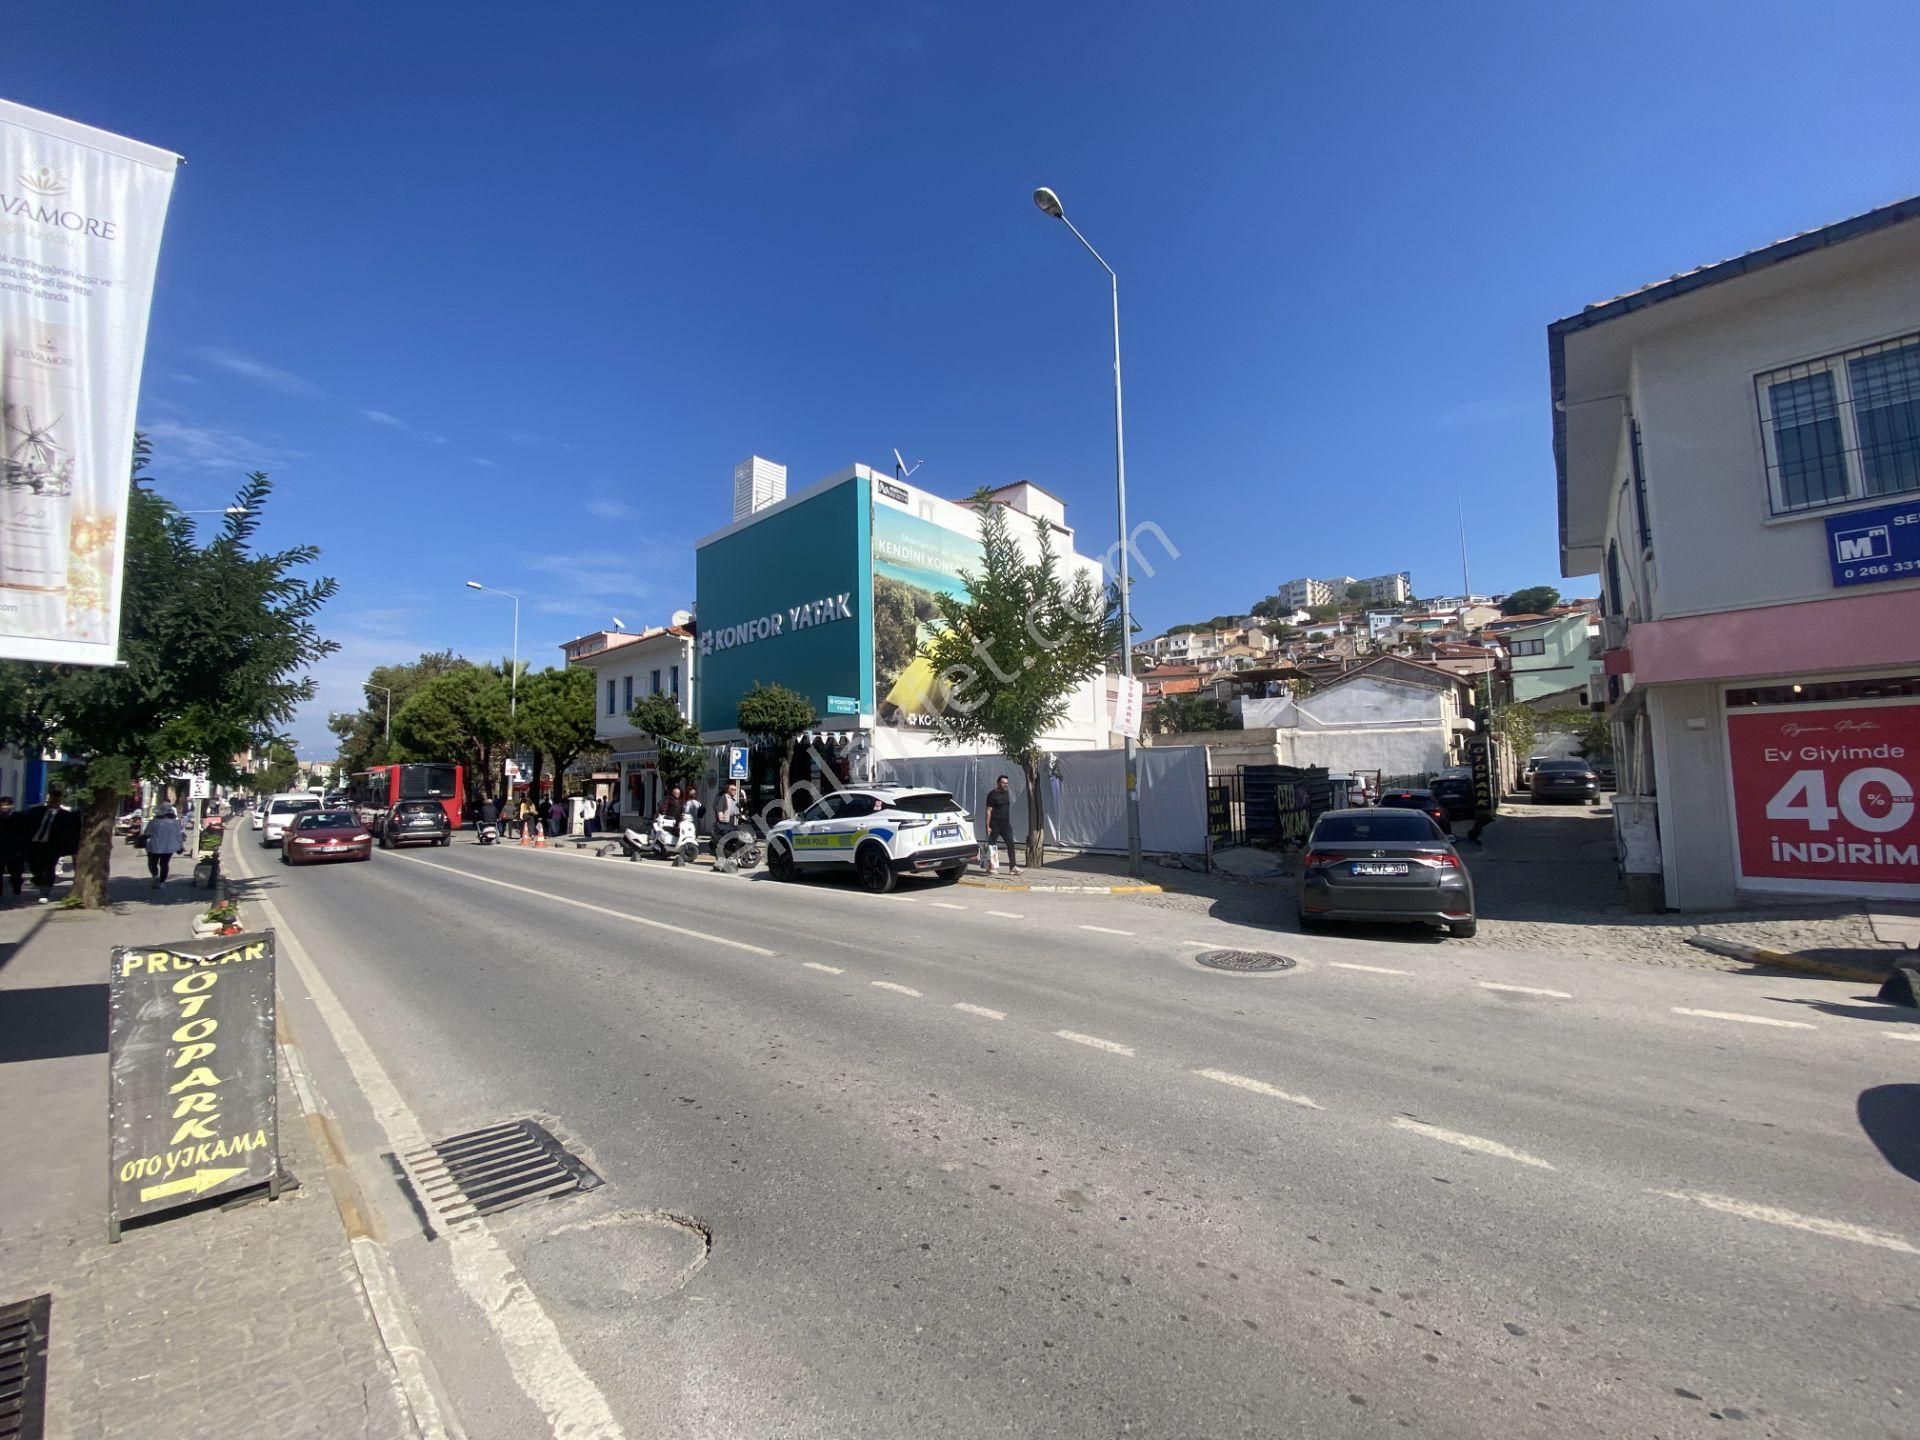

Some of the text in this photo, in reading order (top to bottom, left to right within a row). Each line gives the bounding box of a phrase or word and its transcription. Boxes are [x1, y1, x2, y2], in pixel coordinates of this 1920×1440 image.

[101, 277, 112, 288] ve
[879, 540, 925, 564] KENDİNİ
[1845, 569, 1855, 578] 0
[1859, 564, 1889, 577] 266
[714, 591, 852, 651] KONFOR YATAK
[732, 750, 742, 765] P
[1764, 744, 1905, 764] Ev Giyimde
[1770, 836, 1919, 866] İNDİRİM
[168, 971, 221, 1145] OTOPARK
[120, 1154, 162, 1182] OTO
